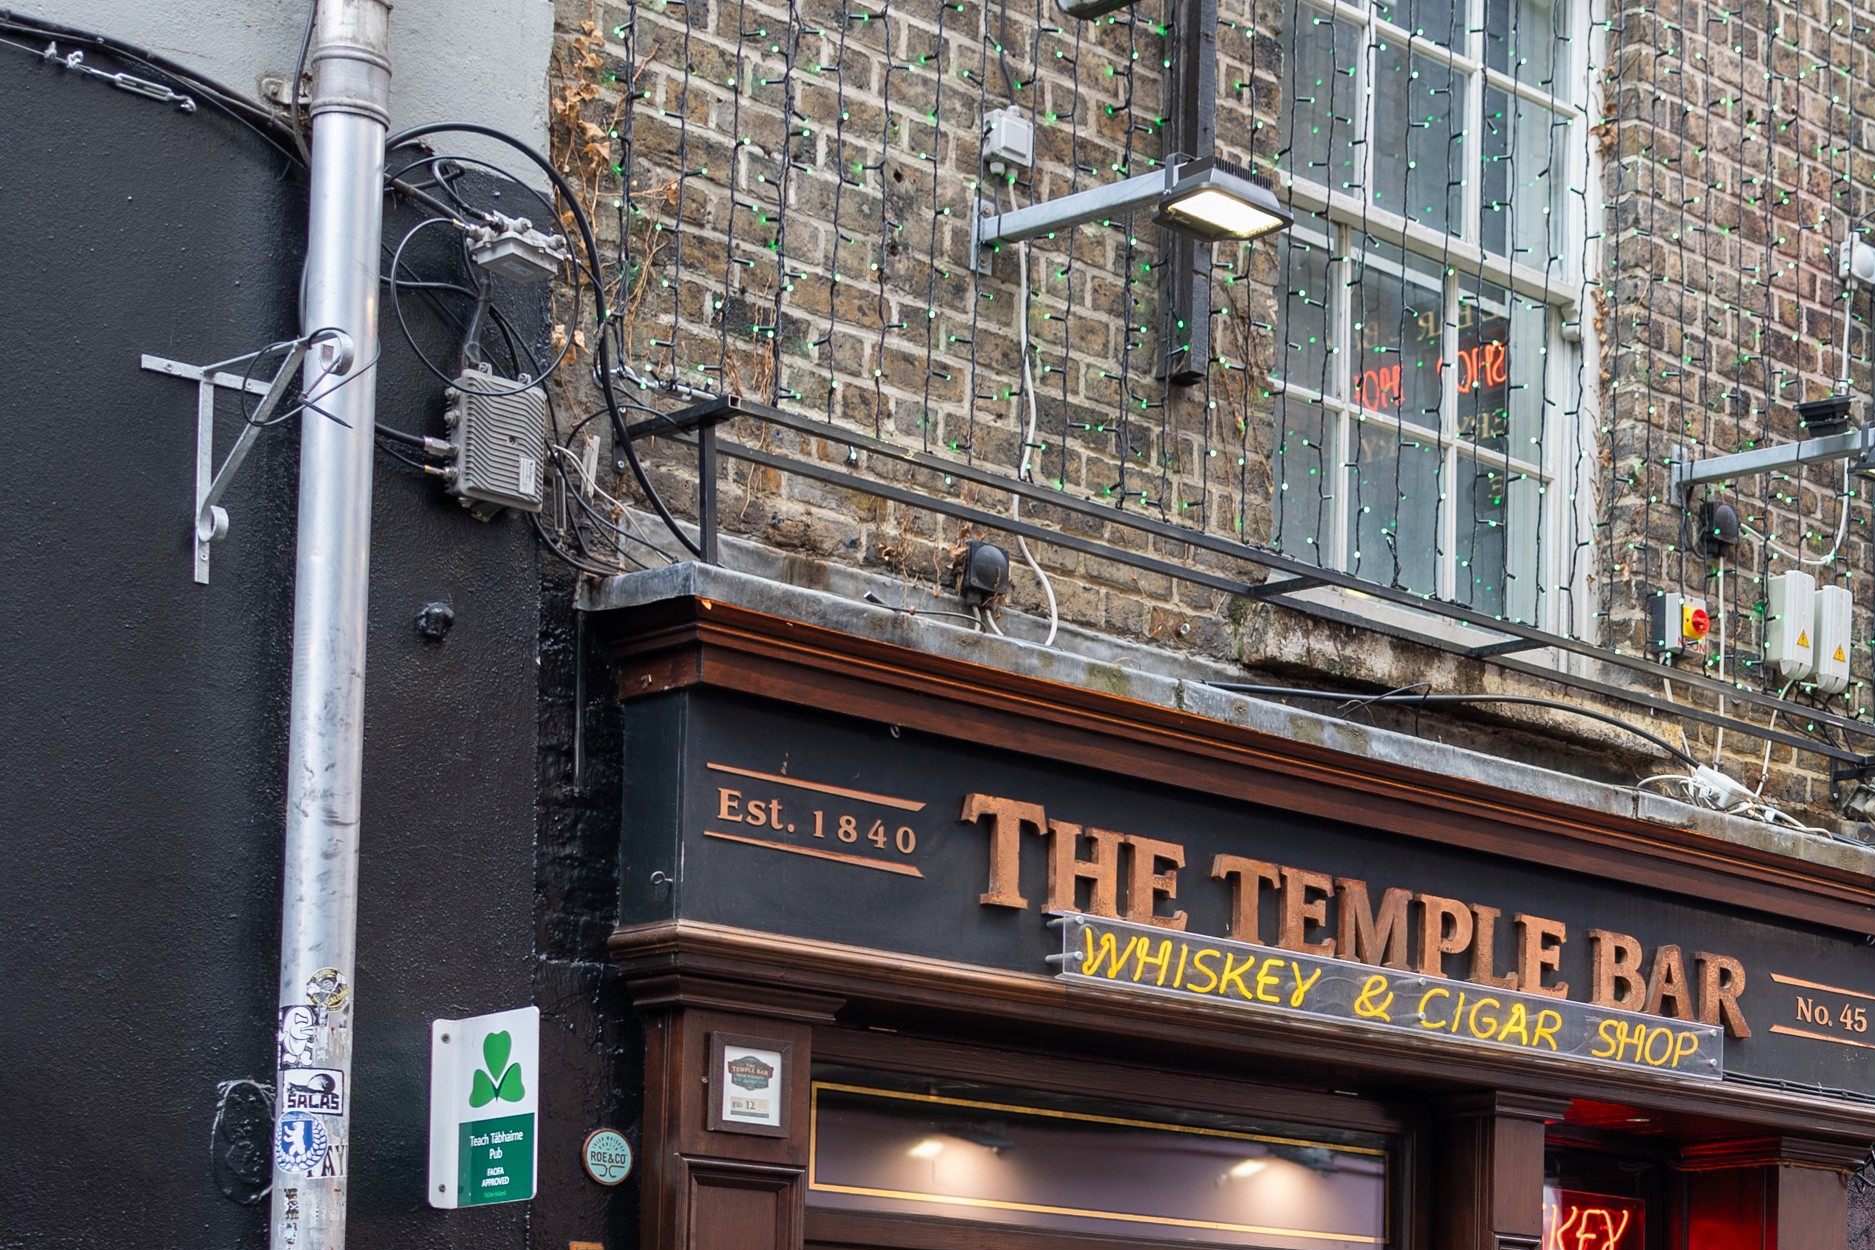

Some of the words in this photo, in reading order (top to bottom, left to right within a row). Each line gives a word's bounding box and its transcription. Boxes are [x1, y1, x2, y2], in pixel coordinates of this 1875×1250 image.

[1678, 635, 1706, 653] NEON
[717, 787, 796, 834] Est.
[813, 810, 917, 855] 1840
[960, 793, 1187, 932] THE
[1211, 853, 1567, 1000] TEMPLE
[1589, 929, 1752, 1038] BAR
[1082, 927, 1322, 1007] WHISKEY
[1354, 974, 1391, 1023] &
[1417, 987, 1564, 1051] CIGAR
[1592, 1018, 1700, 1068] SHOP
[1796, 996, 1835, 1028] No.
[1839, 1002, 1869, 1033] 45
[745, 1100, 756, 1110] 12
[469, 1133, 489, 1147] Teach
[489, 1146, 503, 1159] Pub
[590, 1150, 627, 1165] ROE&CO
[481, 1176, 510, 1188] APPROVED
